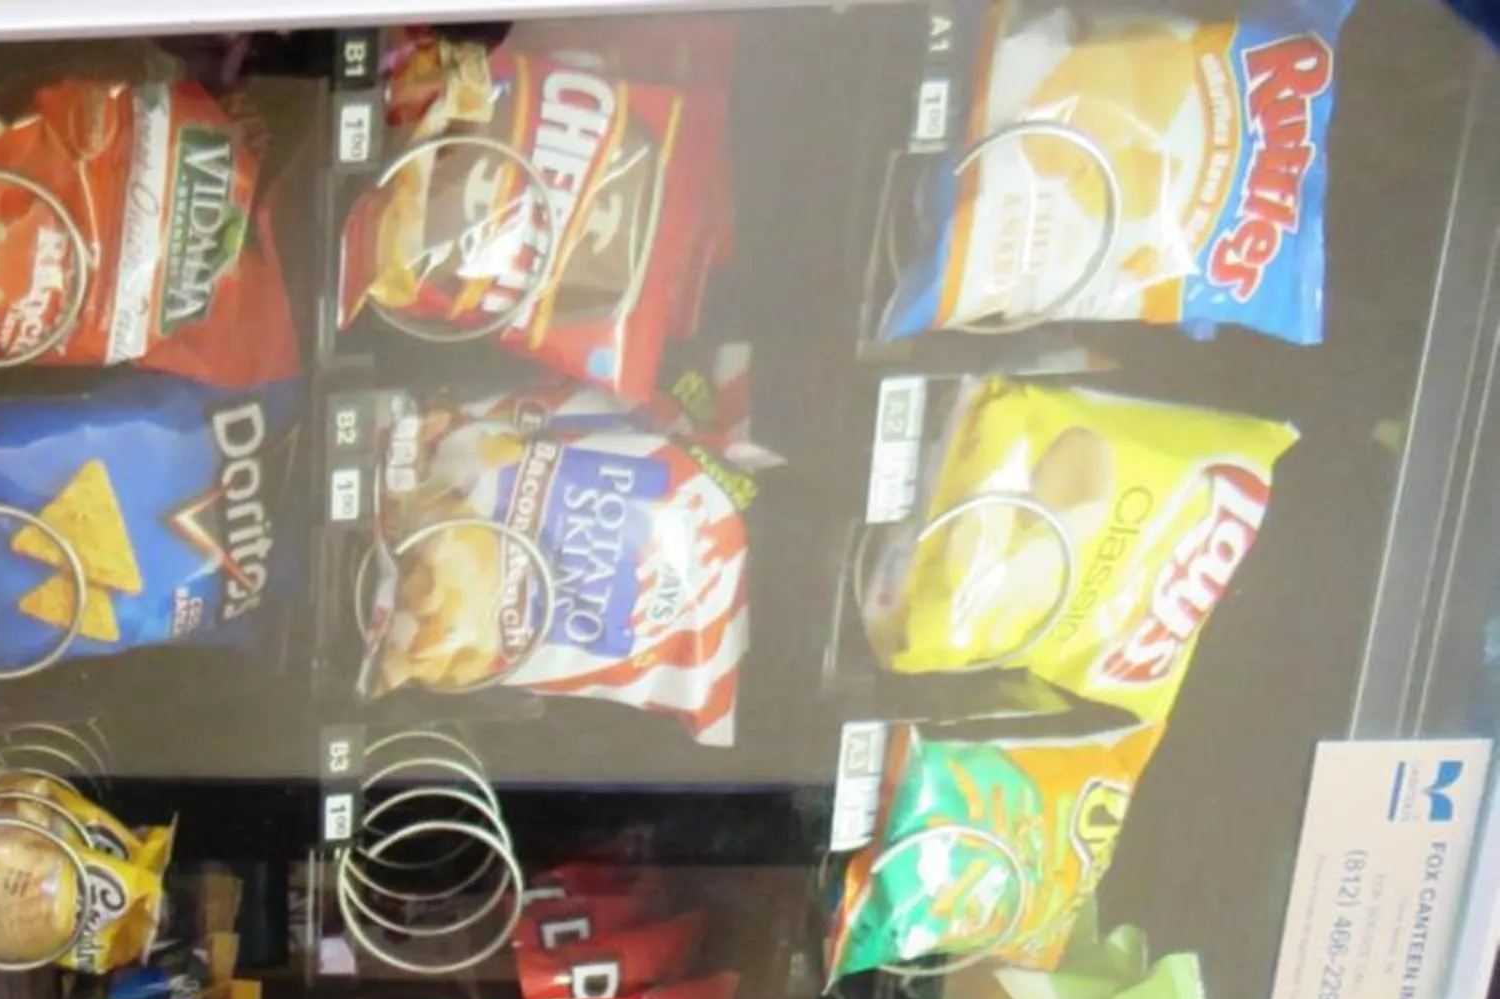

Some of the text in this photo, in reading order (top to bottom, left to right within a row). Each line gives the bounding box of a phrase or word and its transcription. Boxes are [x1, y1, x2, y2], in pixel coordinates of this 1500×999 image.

[344, 41, 366, 77] B1
[928, 11, 953, 53] A1
[1206, 30, 1334, 304] Ruffles
[164, 141, 232, 323] VIDALIA
[336, 409, 357, 445] B2
[212, 401, 274, 620] Doritos
[510, 440, 557, 534] Bacon
[552, 484, 599, 620] SKINS
[563, 462, 637, 644] POTATO
[1051, 486, 1154, 645] Classic
[329, 741, 350, 772] B3
[1336, 850, 1370, 908] (812)
[1424, 841, 1447, 881] FOX
[1404, 887, 1437, 980] CANTEEN
